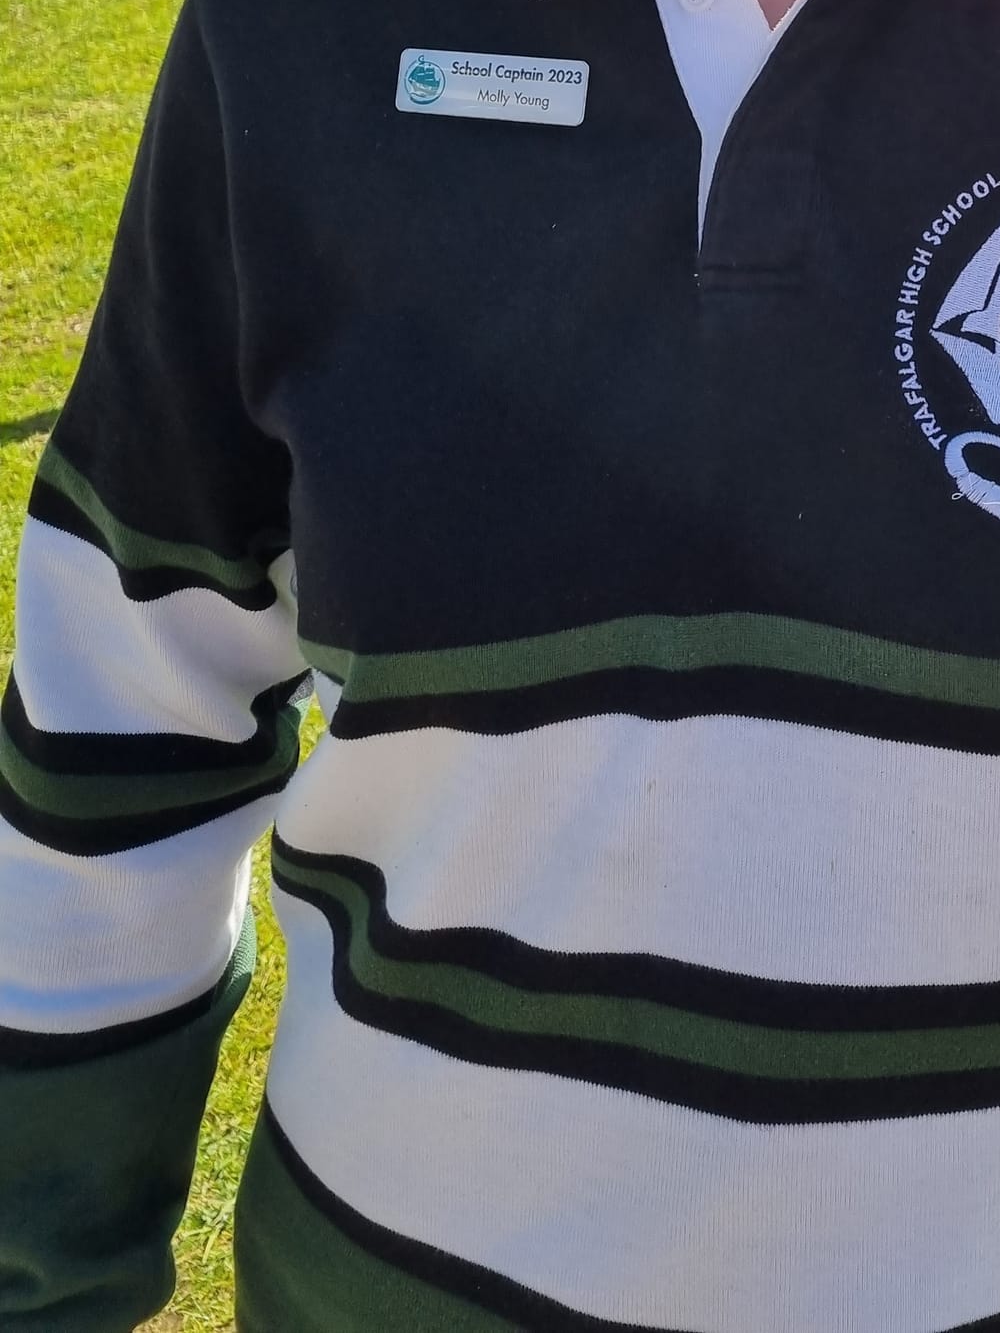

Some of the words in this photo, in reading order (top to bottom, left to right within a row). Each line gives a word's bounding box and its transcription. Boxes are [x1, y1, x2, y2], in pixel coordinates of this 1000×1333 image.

[451, 61, 491, 77] School
[496, 65, 543, 83] Captain
[548, 69, 583, 84] 2023
[477, 89, 510, 106] Molly
[514, 92, 550, 110] Young
[898, 246, 933, 306] HIGH
[894, 310, 948, 450] TRAFALGAR
